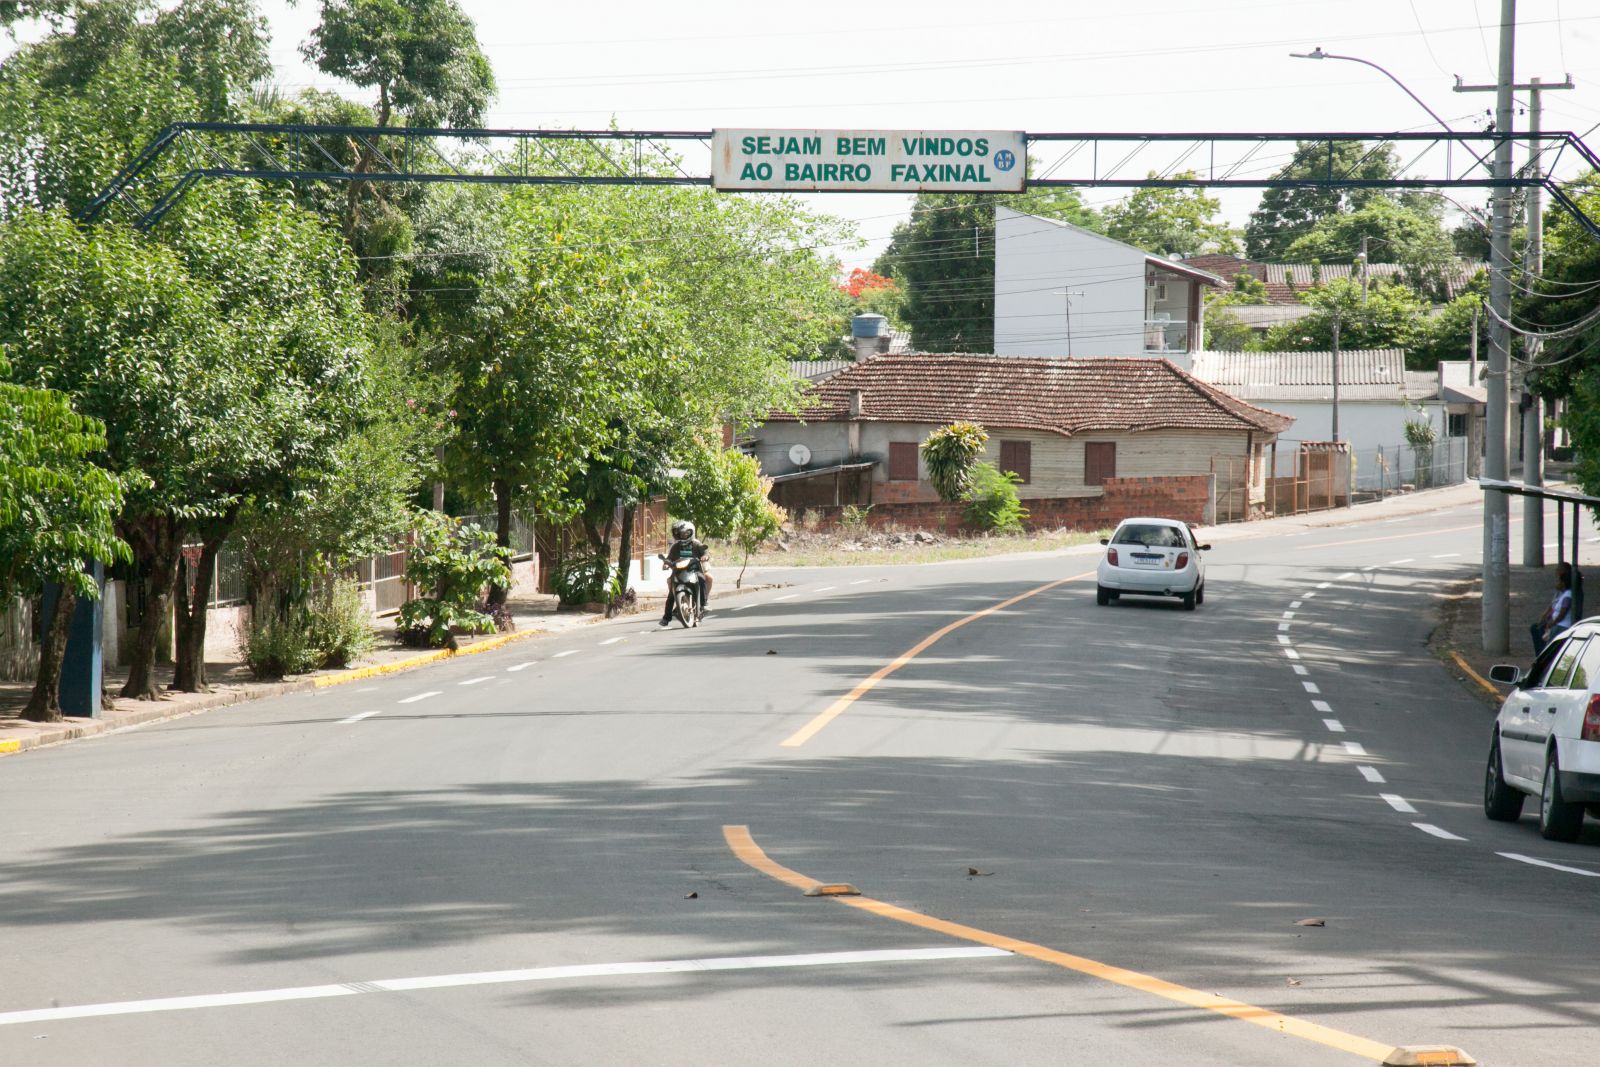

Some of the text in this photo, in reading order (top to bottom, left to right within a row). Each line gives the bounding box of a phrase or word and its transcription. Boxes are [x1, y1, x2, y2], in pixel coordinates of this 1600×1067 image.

[741, 136, 989, 157] SEJAM BEM VINDOS
[740, 162, 992, 183] AO BAIRRO FAXINAL
